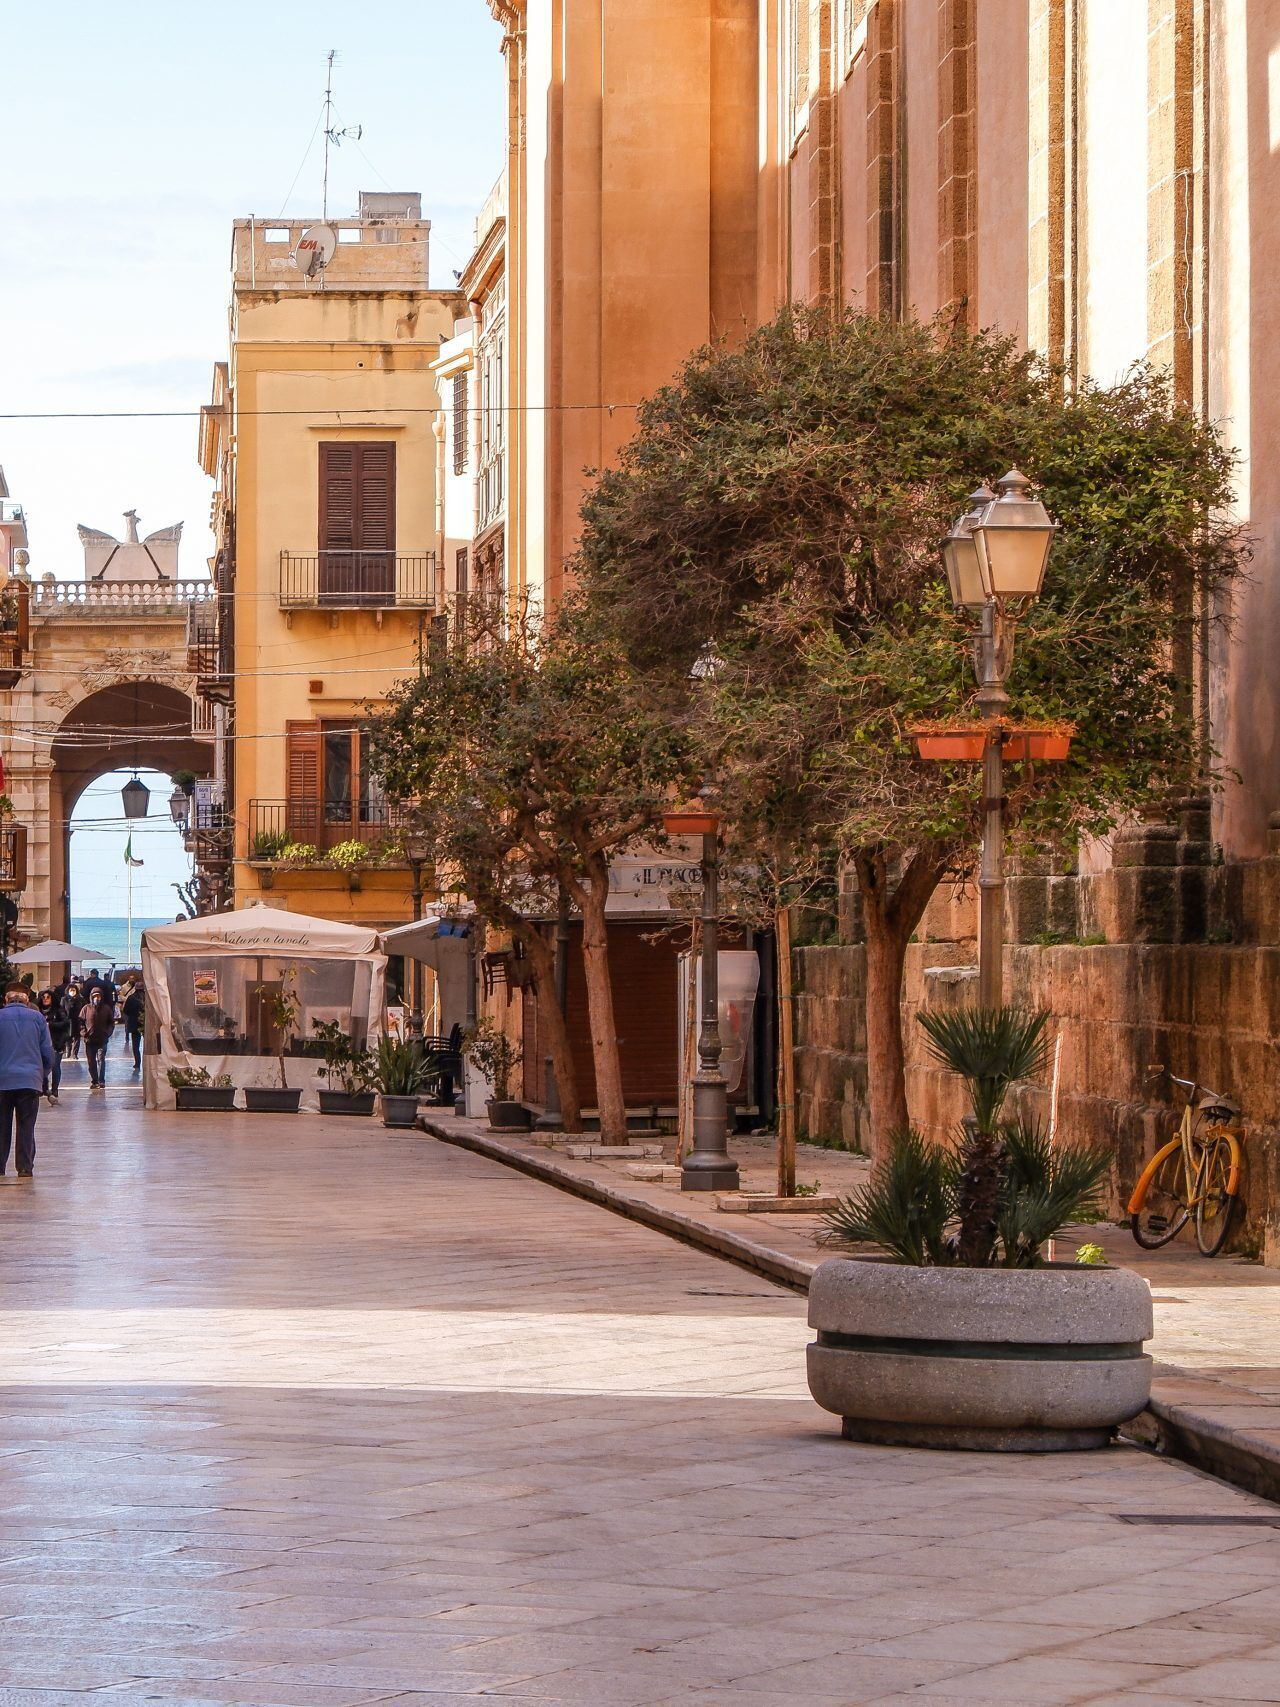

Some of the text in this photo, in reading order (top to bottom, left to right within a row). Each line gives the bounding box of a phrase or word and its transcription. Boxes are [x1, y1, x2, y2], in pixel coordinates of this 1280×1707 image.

[643, 868, 656, 884] IL
[210, 931, 260, 945] Natura
[273, 933, 310, 945] tavola
